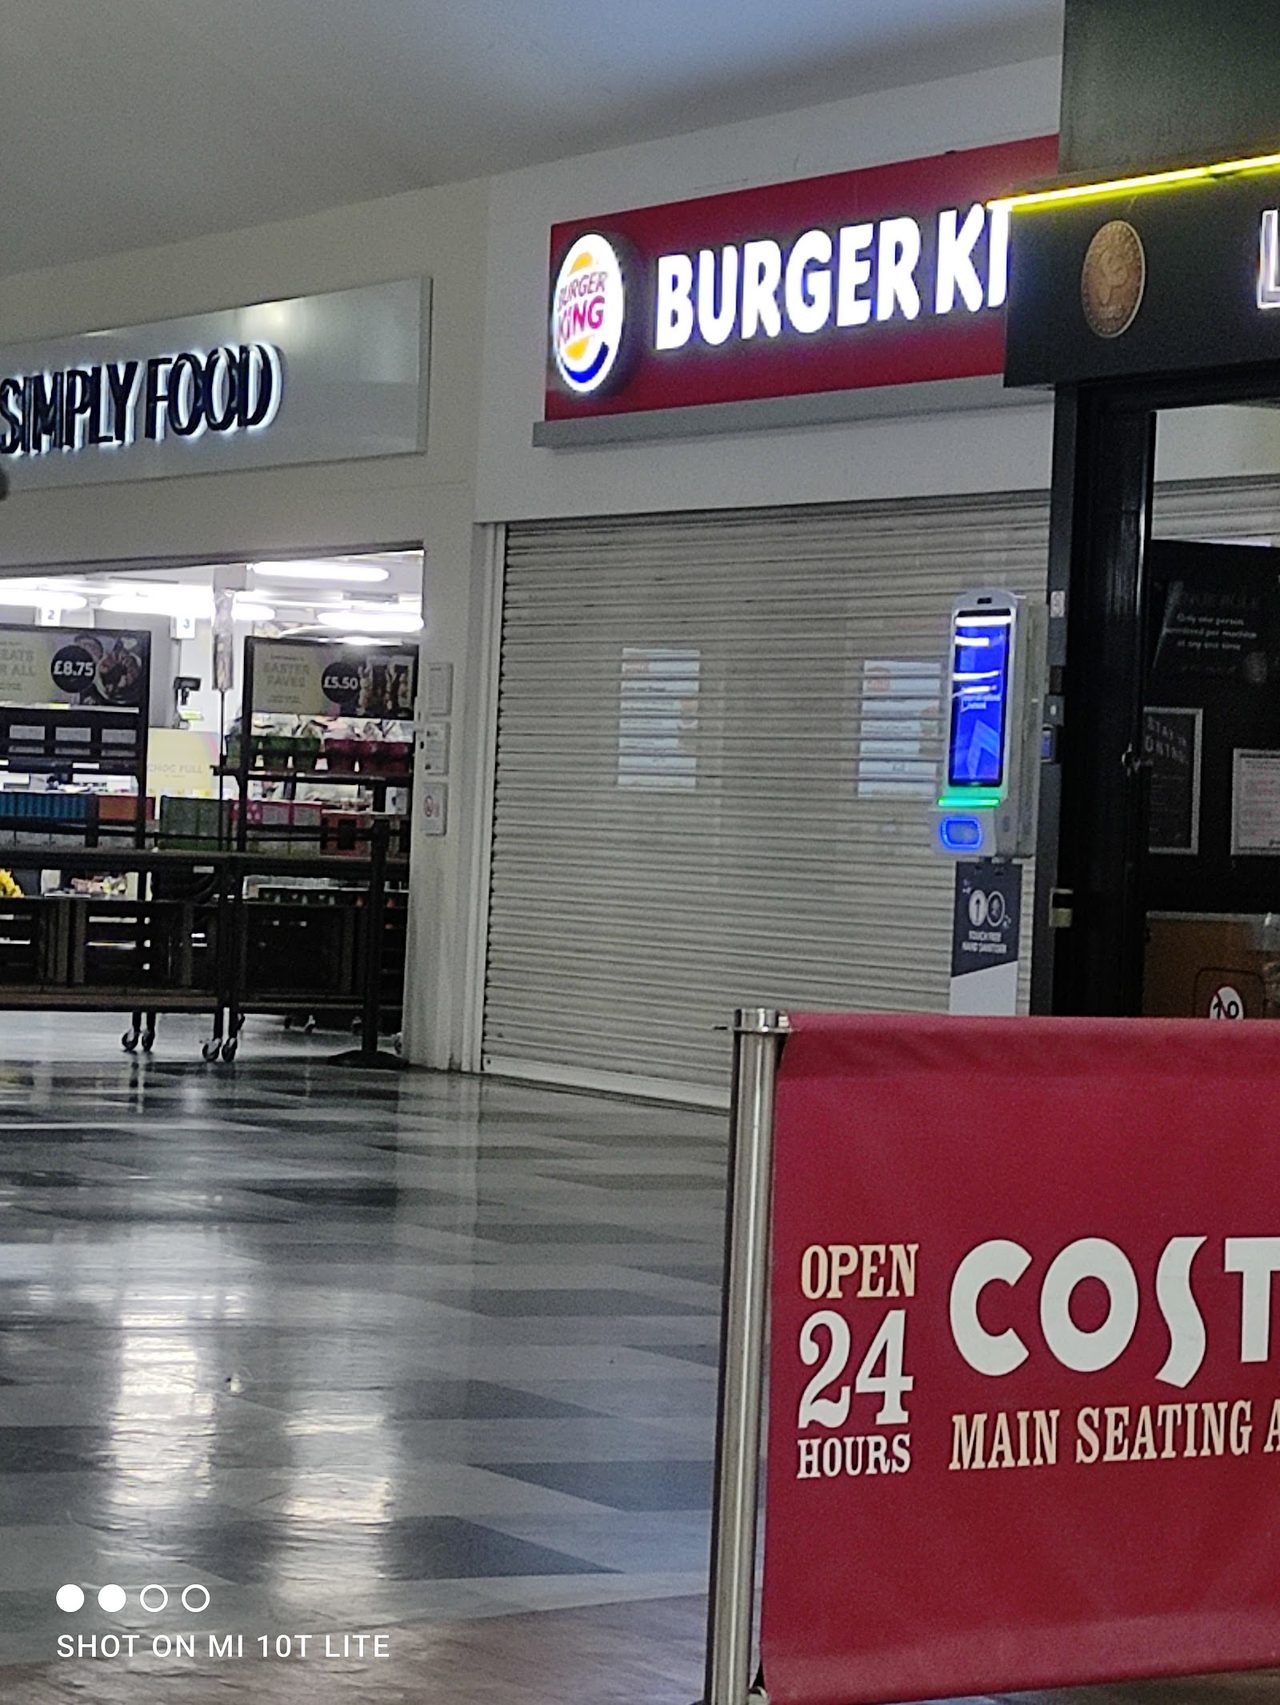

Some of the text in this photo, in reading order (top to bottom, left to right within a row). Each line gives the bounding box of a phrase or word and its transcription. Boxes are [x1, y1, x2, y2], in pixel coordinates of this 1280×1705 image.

[558, 271, 608, 312] BURGER
[655, 215, 921, 351] BURGER
[557, 295, 606, 348] KING
[0, 343, 281, 455] SIMPLY FOOD
[47, 609, 55, 620] 2
[53, 660, 94, 677] £8.75
[323, 676, 358, 689] £5.50
[802, 1243, 919, 1299] OPEN
[949, 1235, 1280, 1388] COST
[797, 1309, 914, 1428] 24
[797, 1433, 912, 1480] HOURS
[949, 1409, 1060, 1471] MAIN
[1076, 1399, 1253, 1464] SEATING
